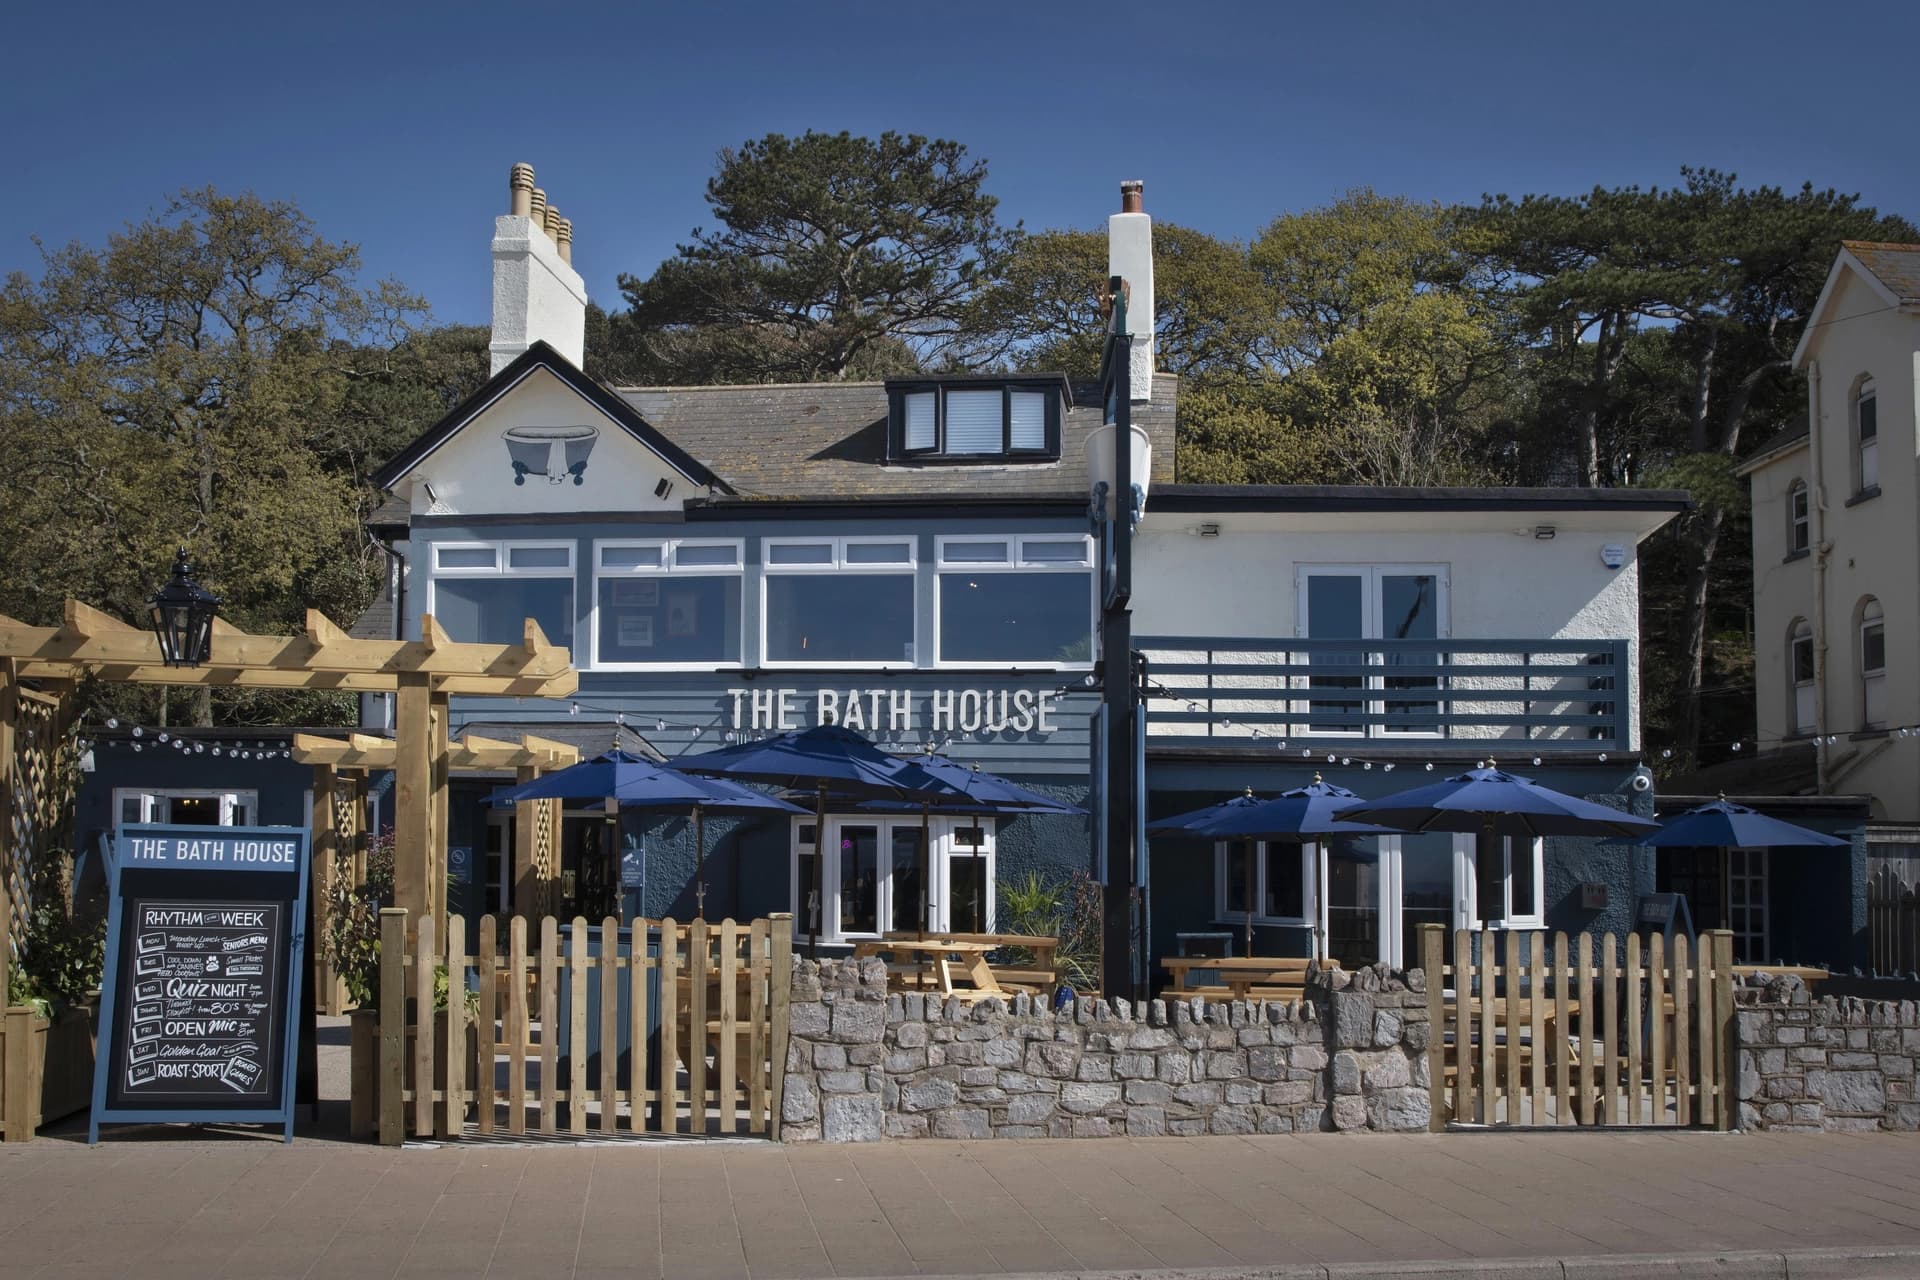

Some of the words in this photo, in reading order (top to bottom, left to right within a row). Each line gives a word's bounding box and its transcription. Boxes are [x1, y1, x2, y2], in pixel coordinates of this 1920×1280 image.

[727, 688, 797, 730] THE
[817, 688, 912, 731] BATH
[933, 689, 1059, 732] HOUSE
[132, 839, 168, 860] THE
[176, 840, 225, 861] BATH
[233, 841, 295, 863] HOUSE
[145, 911, 204, 926] RHYTHM
[221, 912, 264, 927] WEEK
[223, 937, 249, 951] SENIORS
[249, 935, 268, 945] MENU
[166, 977, 210, 999] Quiz
[210, 983, 248, 998] NIGHT
[165, 1021, 206, 1036] OPEN
[135, 1045, 150, 1054] SAT
[160, 1043, 195, 1057] Golden
[195, 1043, 221, 1057] Goal
[234, 1059, 257, 1073] BOARD
[230, 1068, 253, 1086] GAMES
